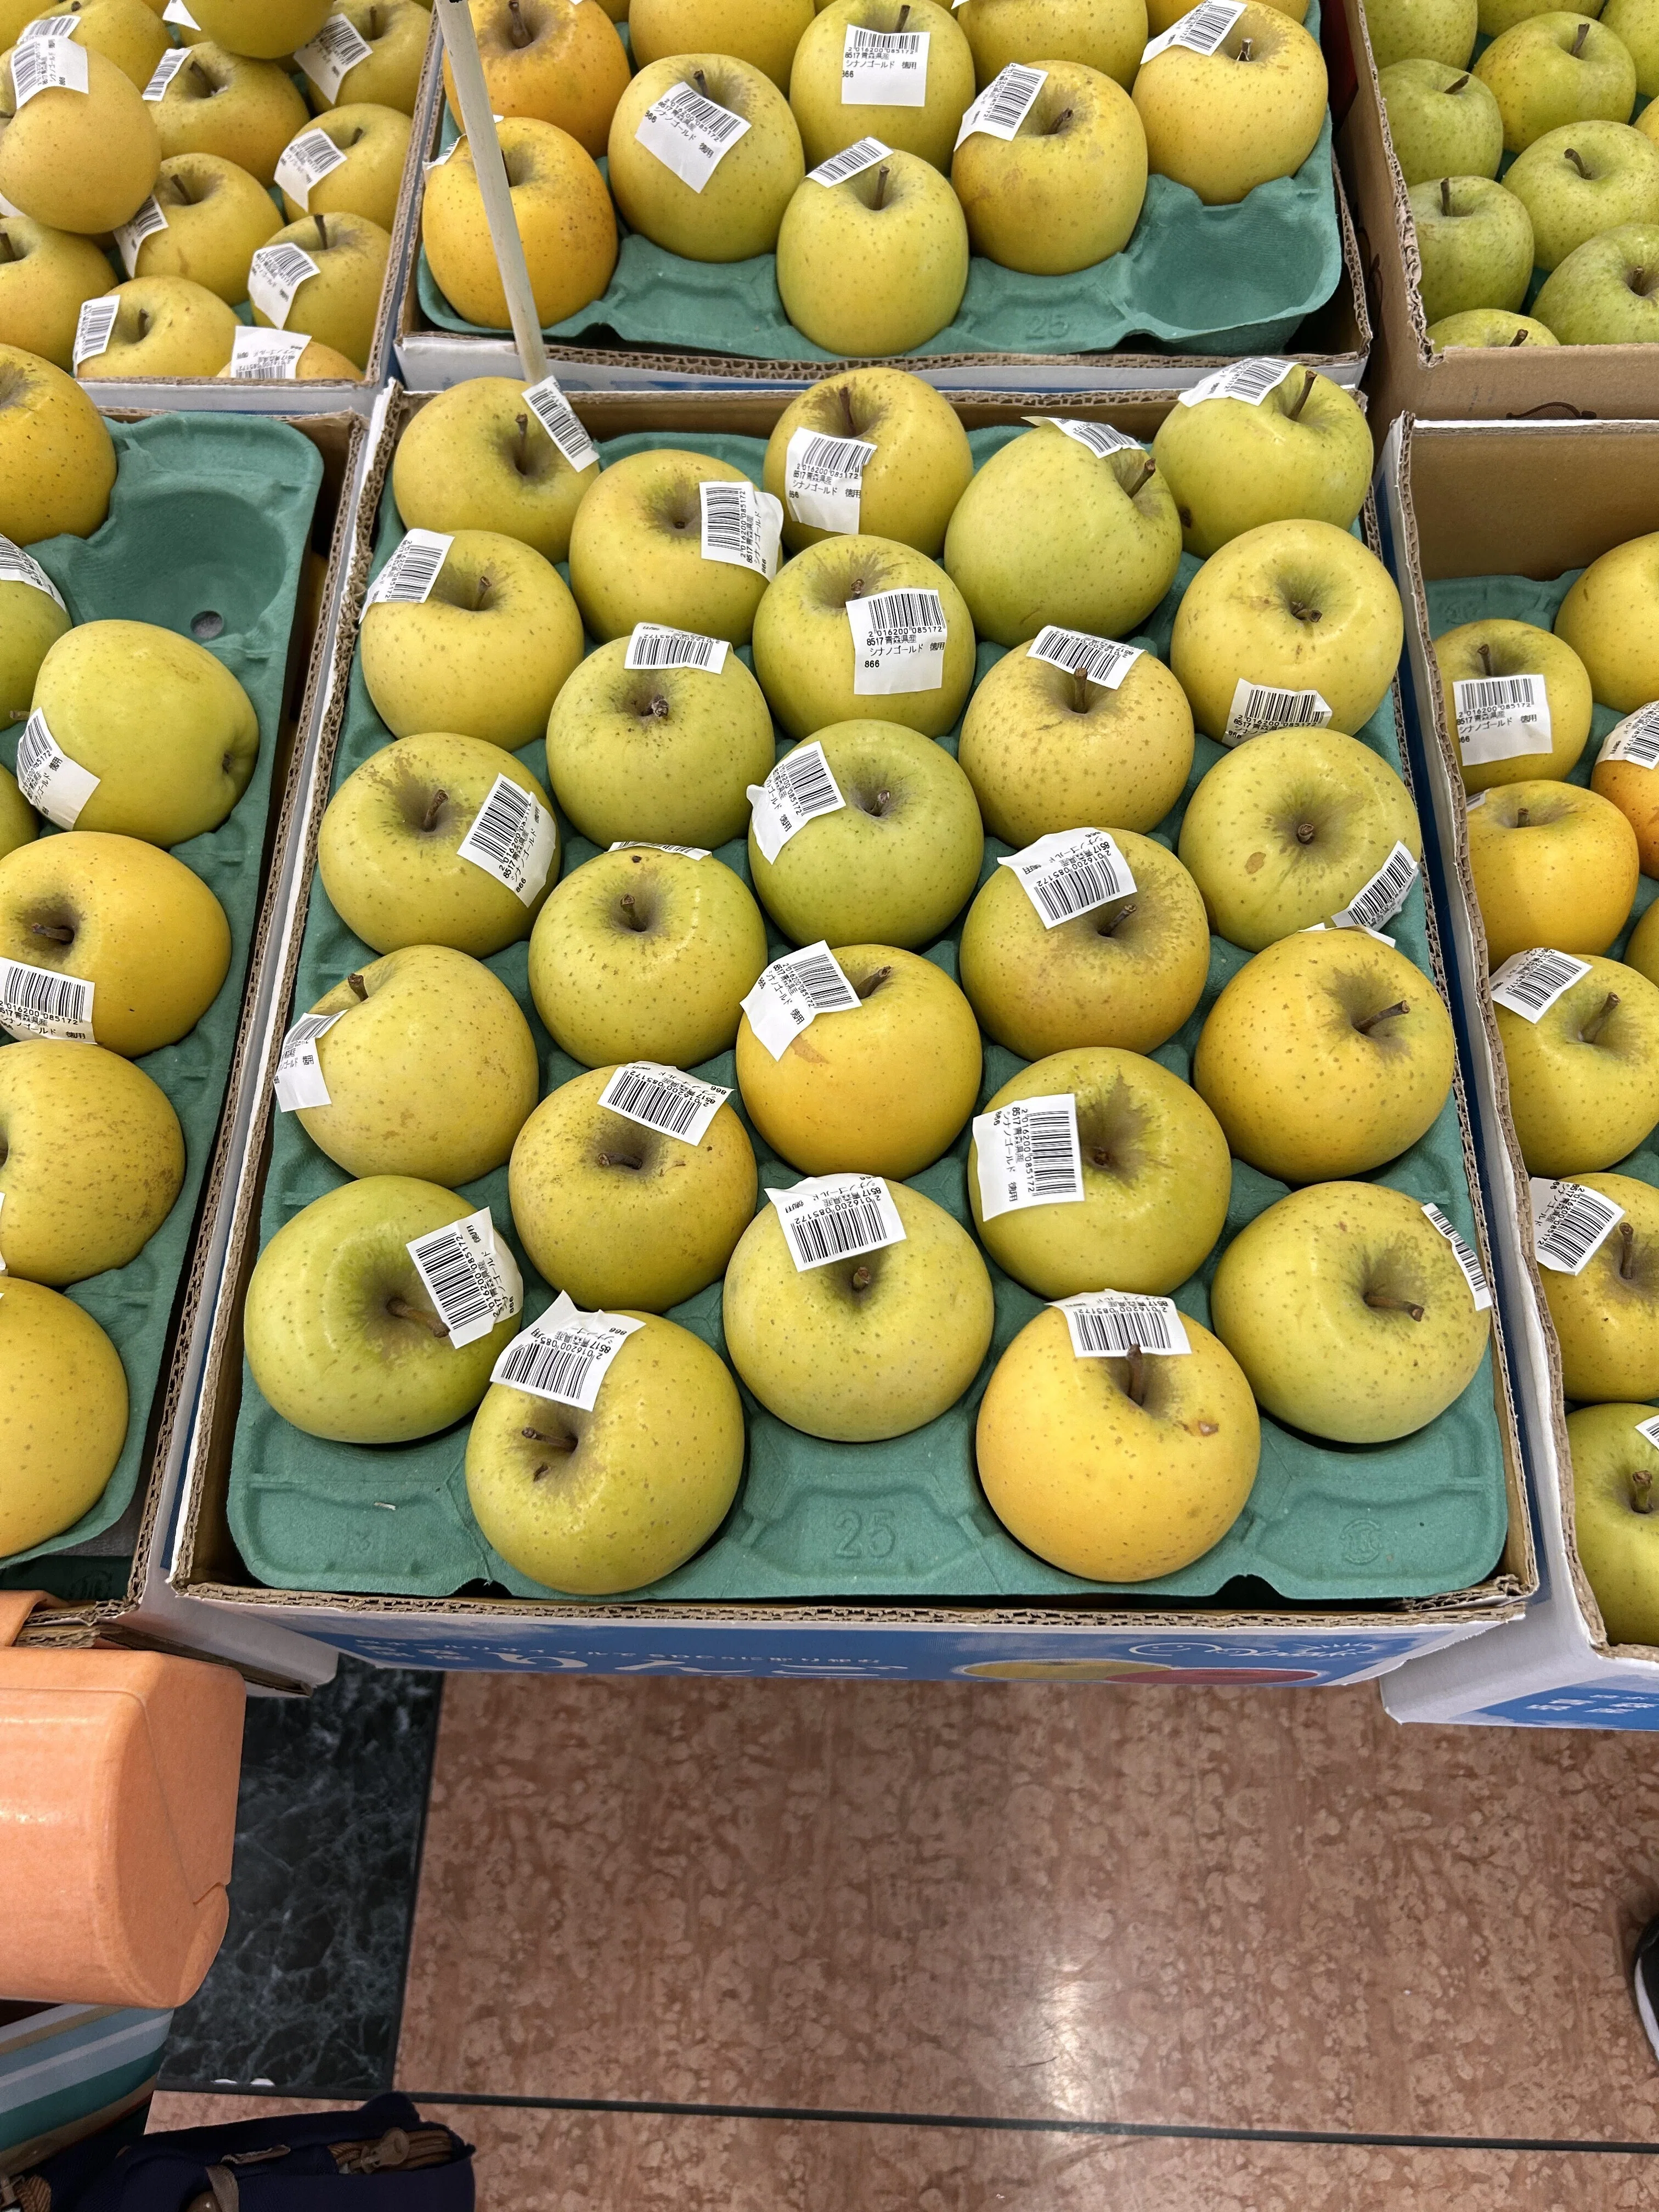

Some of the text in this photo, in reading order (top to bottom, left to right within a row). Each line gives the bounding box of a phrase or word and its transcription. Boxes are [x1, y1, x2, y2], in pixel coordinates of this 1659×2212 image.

[846, 60, 895, 69] シナノゴールド
[802, 464, 828, 475] 016200
[830, 470, 859, 479] 085172
[793, 479, 838, 496] シナノゴールド
[867, 634, 917, 646] 8517 青森県産
[877, 628, 909, 636] 016200
[870, 644, 923, 657] シナノゴールド
[864, 659, 879, 668] 866
[1466, 706, 1497, 716] 016200
[1233, 718, 1251, 728] 8517
[1246, 717, 1280, 726] 016200
[1459, 717, 1512, 734] シナノゴールド
[787, 789, 802, 815] 085172
[503, 833, 521, 864] 016200
[511, 828, 537, 882] シナノゴールド
[1049, 836, 1103, 863] シナノゴールド
[1093, 842, 1110, 854] 8517
[503, 860, 515, 878] 8517
[1072, 853, 1104, 870] 016200
[516, 878, 526, 893] 866
[1036, 867, 1070, 887] 085172
[766, 970, 792, 1005] シナノゴールド
[786, 967, 801, 985] 016200
[798, 986, 815, 1007] 085172
[7, 1003, 40, 1017] 016200
[43, 1013, 78, 1025] 085172
[630, 1070, 664, 1087] 085172
[667, 1085, 700, 1103] 016200
[697, 1094, 715, 1104] 8517
[710, 1086, 727, 1095] 866
[1012, 1107, 1020, 1125] 8517
[1003, 1111, 1015, 1172] シナノゴールド
[1022, 1116, 1030, 1152] 016200
[1025, 1156, 1035, 1192] 085172
[812, 1180, 875, 1200] シナノゴールド
[862, 1187, 881, 1197] 8517
[1550, 1180, 1560, 1189] 66
[1566, 1183, 1580, 1198] 8517
[835, 1197, 872, 1211] 016200
[1534, 1183, 1570, 1226] シナノゴールド
[1558, 1194, 1580, 1218] 016200
[795, 1207, 831, 1224] 085172
[1537, 1220, 1560, 1245] 085172
[456, 1234, 477, 1270] 085172
[475, 1272, 495, 1308] 016200
[561, 1342, 594, 1357] 016200
[590, 1341, 611, 1353] 8517
[834, 1509, 896, 1559] 25
